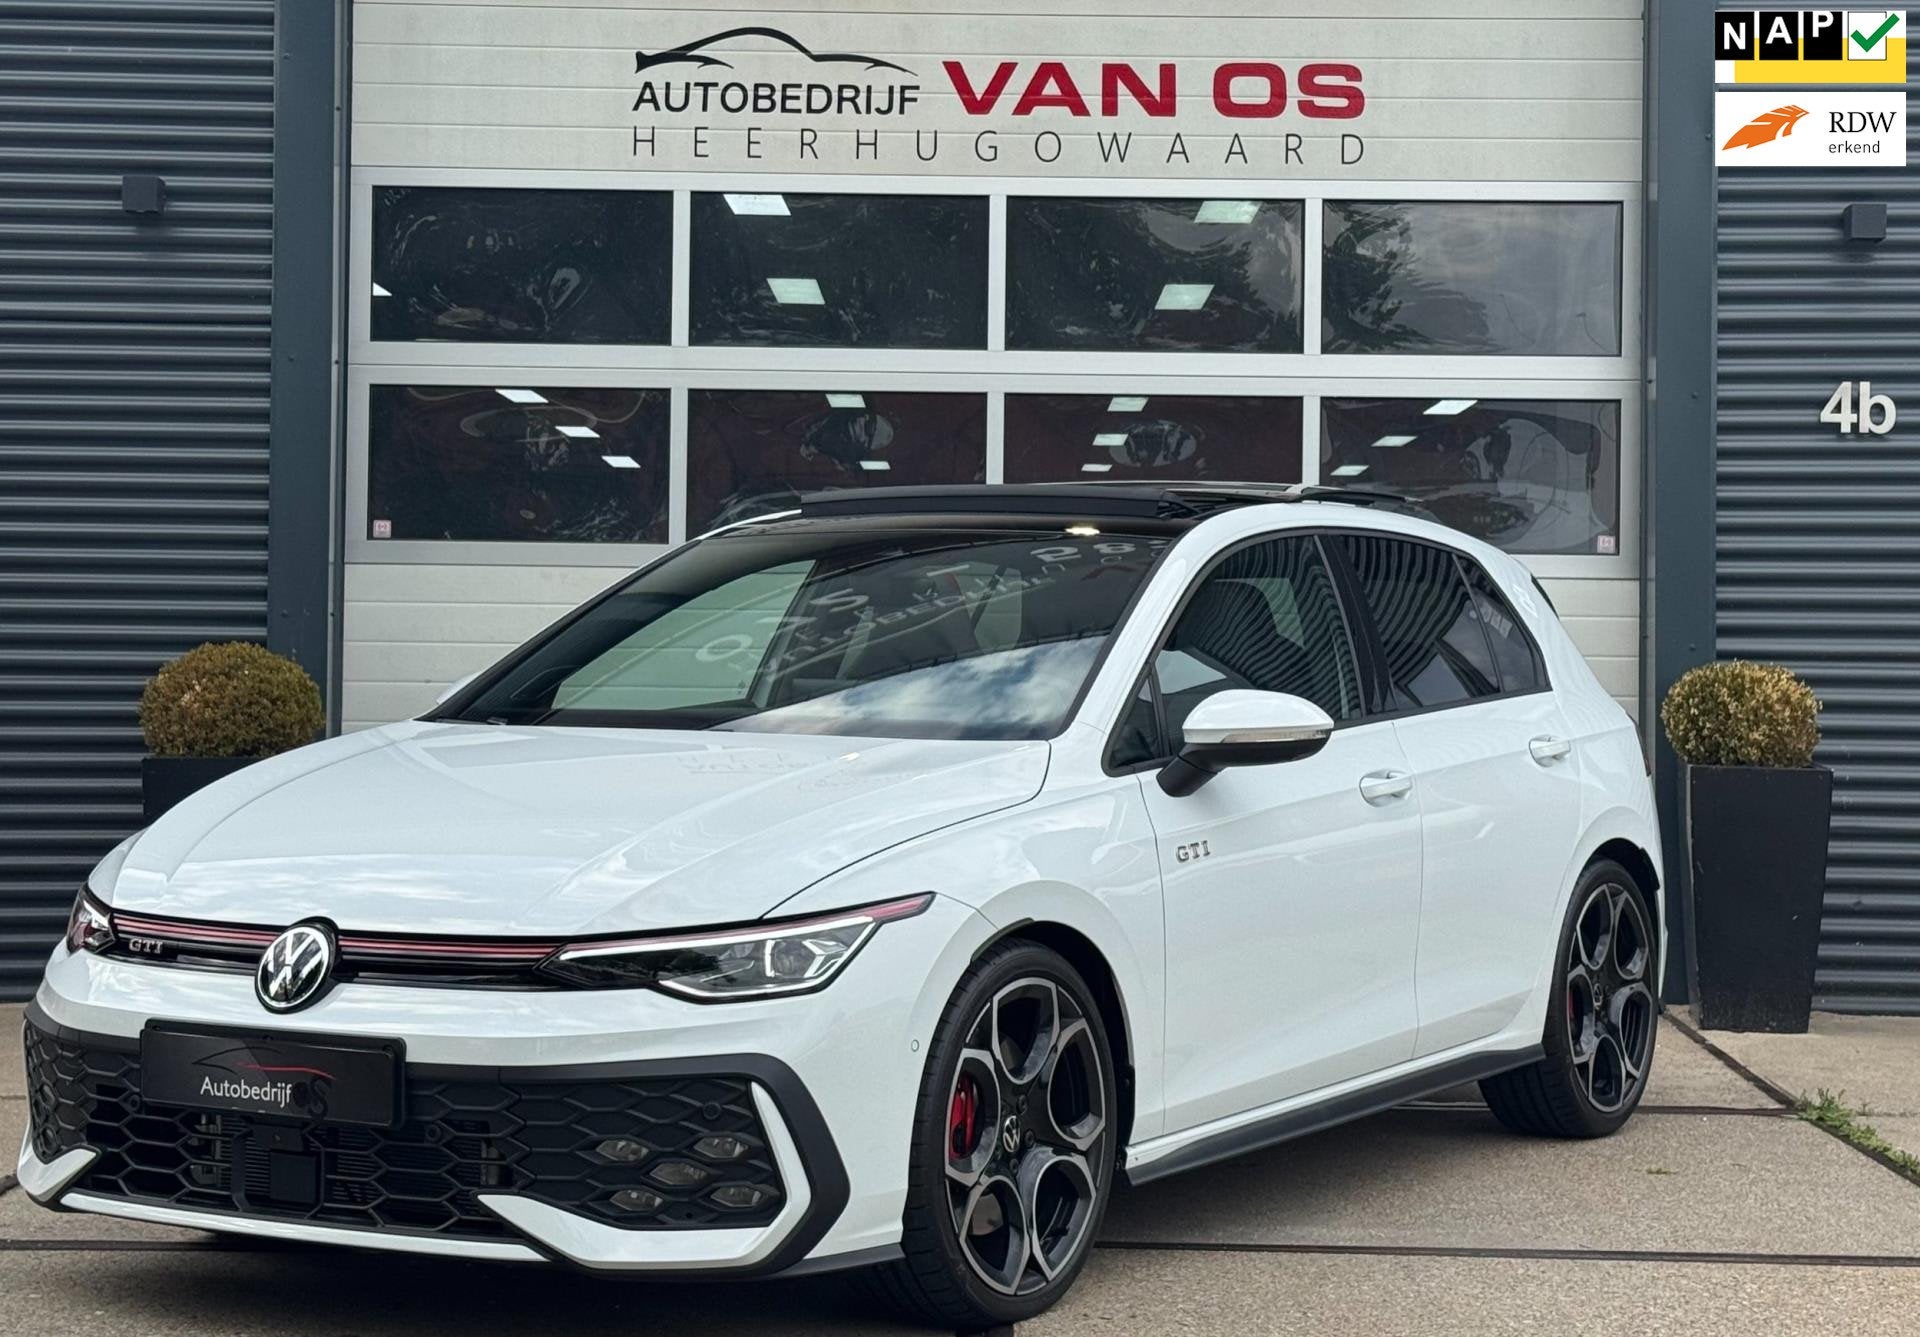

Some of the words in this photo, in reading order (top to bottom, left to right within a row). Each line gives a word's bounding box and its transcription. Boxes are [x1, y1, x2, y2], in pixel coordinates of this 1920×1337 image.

[632, 81, 920, 115] AUTOBEDRIJF
[942, 60, 1177, 117] VAN
[1212, 62, 1366, 119] OS
[632, 124, 1365, 165] HEERHUGOWAARD
[1820, 381, 1897, 435] 4b
[1175, 840, 1212, 863] GTI
[128, 938, 164, 954] GTI
[200, 1076, 293, 1109] Autobedrijf
